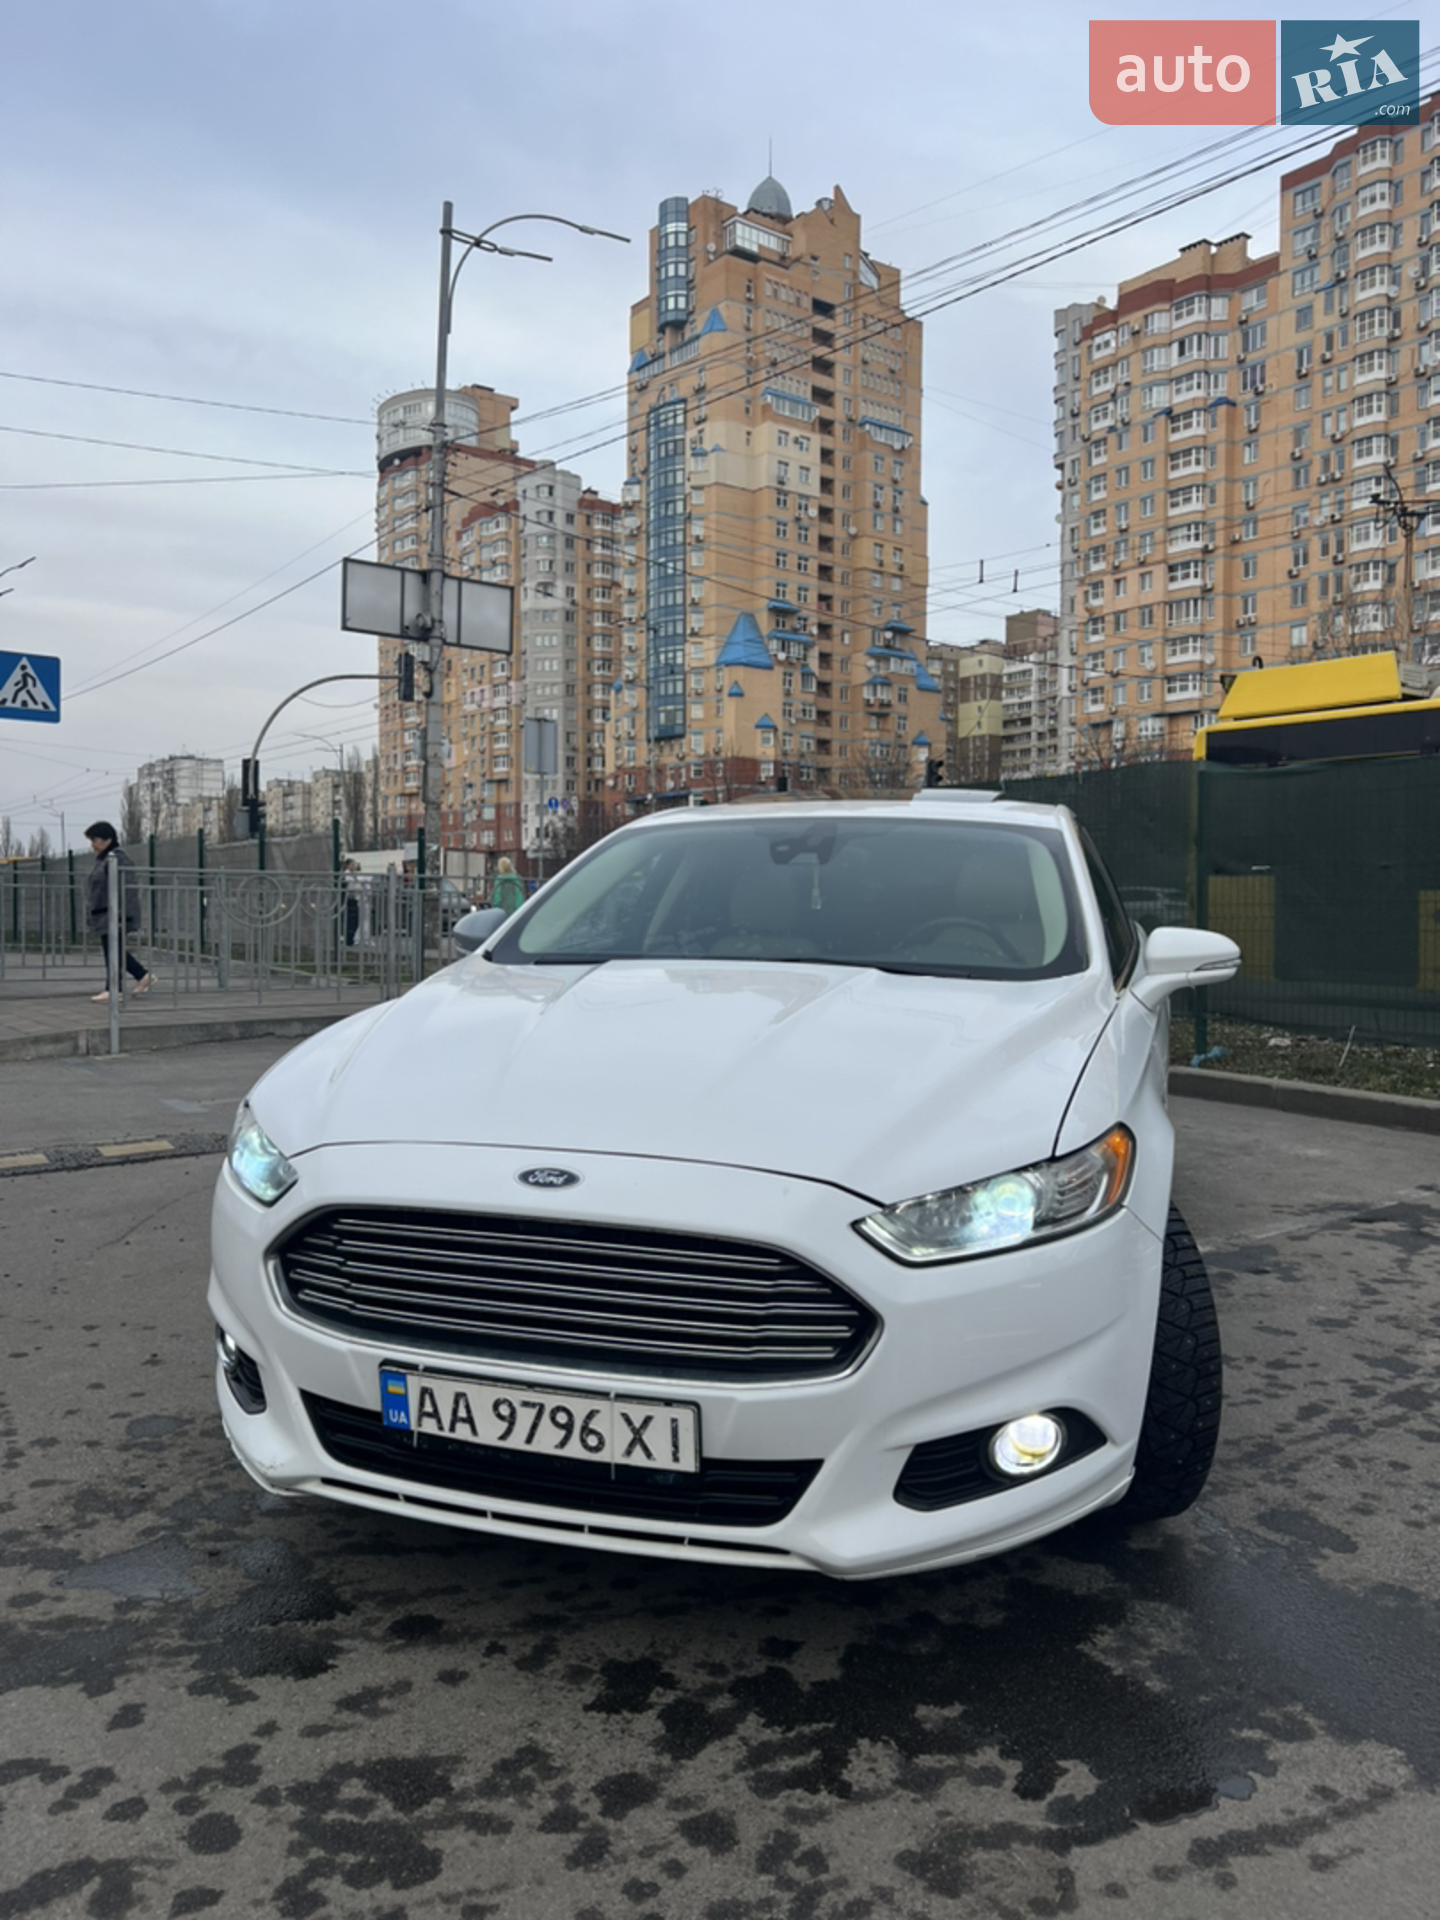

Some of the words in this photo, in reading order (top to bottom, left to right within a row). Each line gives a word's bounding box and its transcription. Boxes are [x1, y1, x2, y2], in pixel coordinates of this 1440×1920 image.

[528, 1169, 568, 1185] Ford
[389, 1408, 408, 1425] UA
[417, 1386, 478, 1437] AA
[492, 1397, 606, 1454] 9796
[620, 1412, 681, 1464] XI
